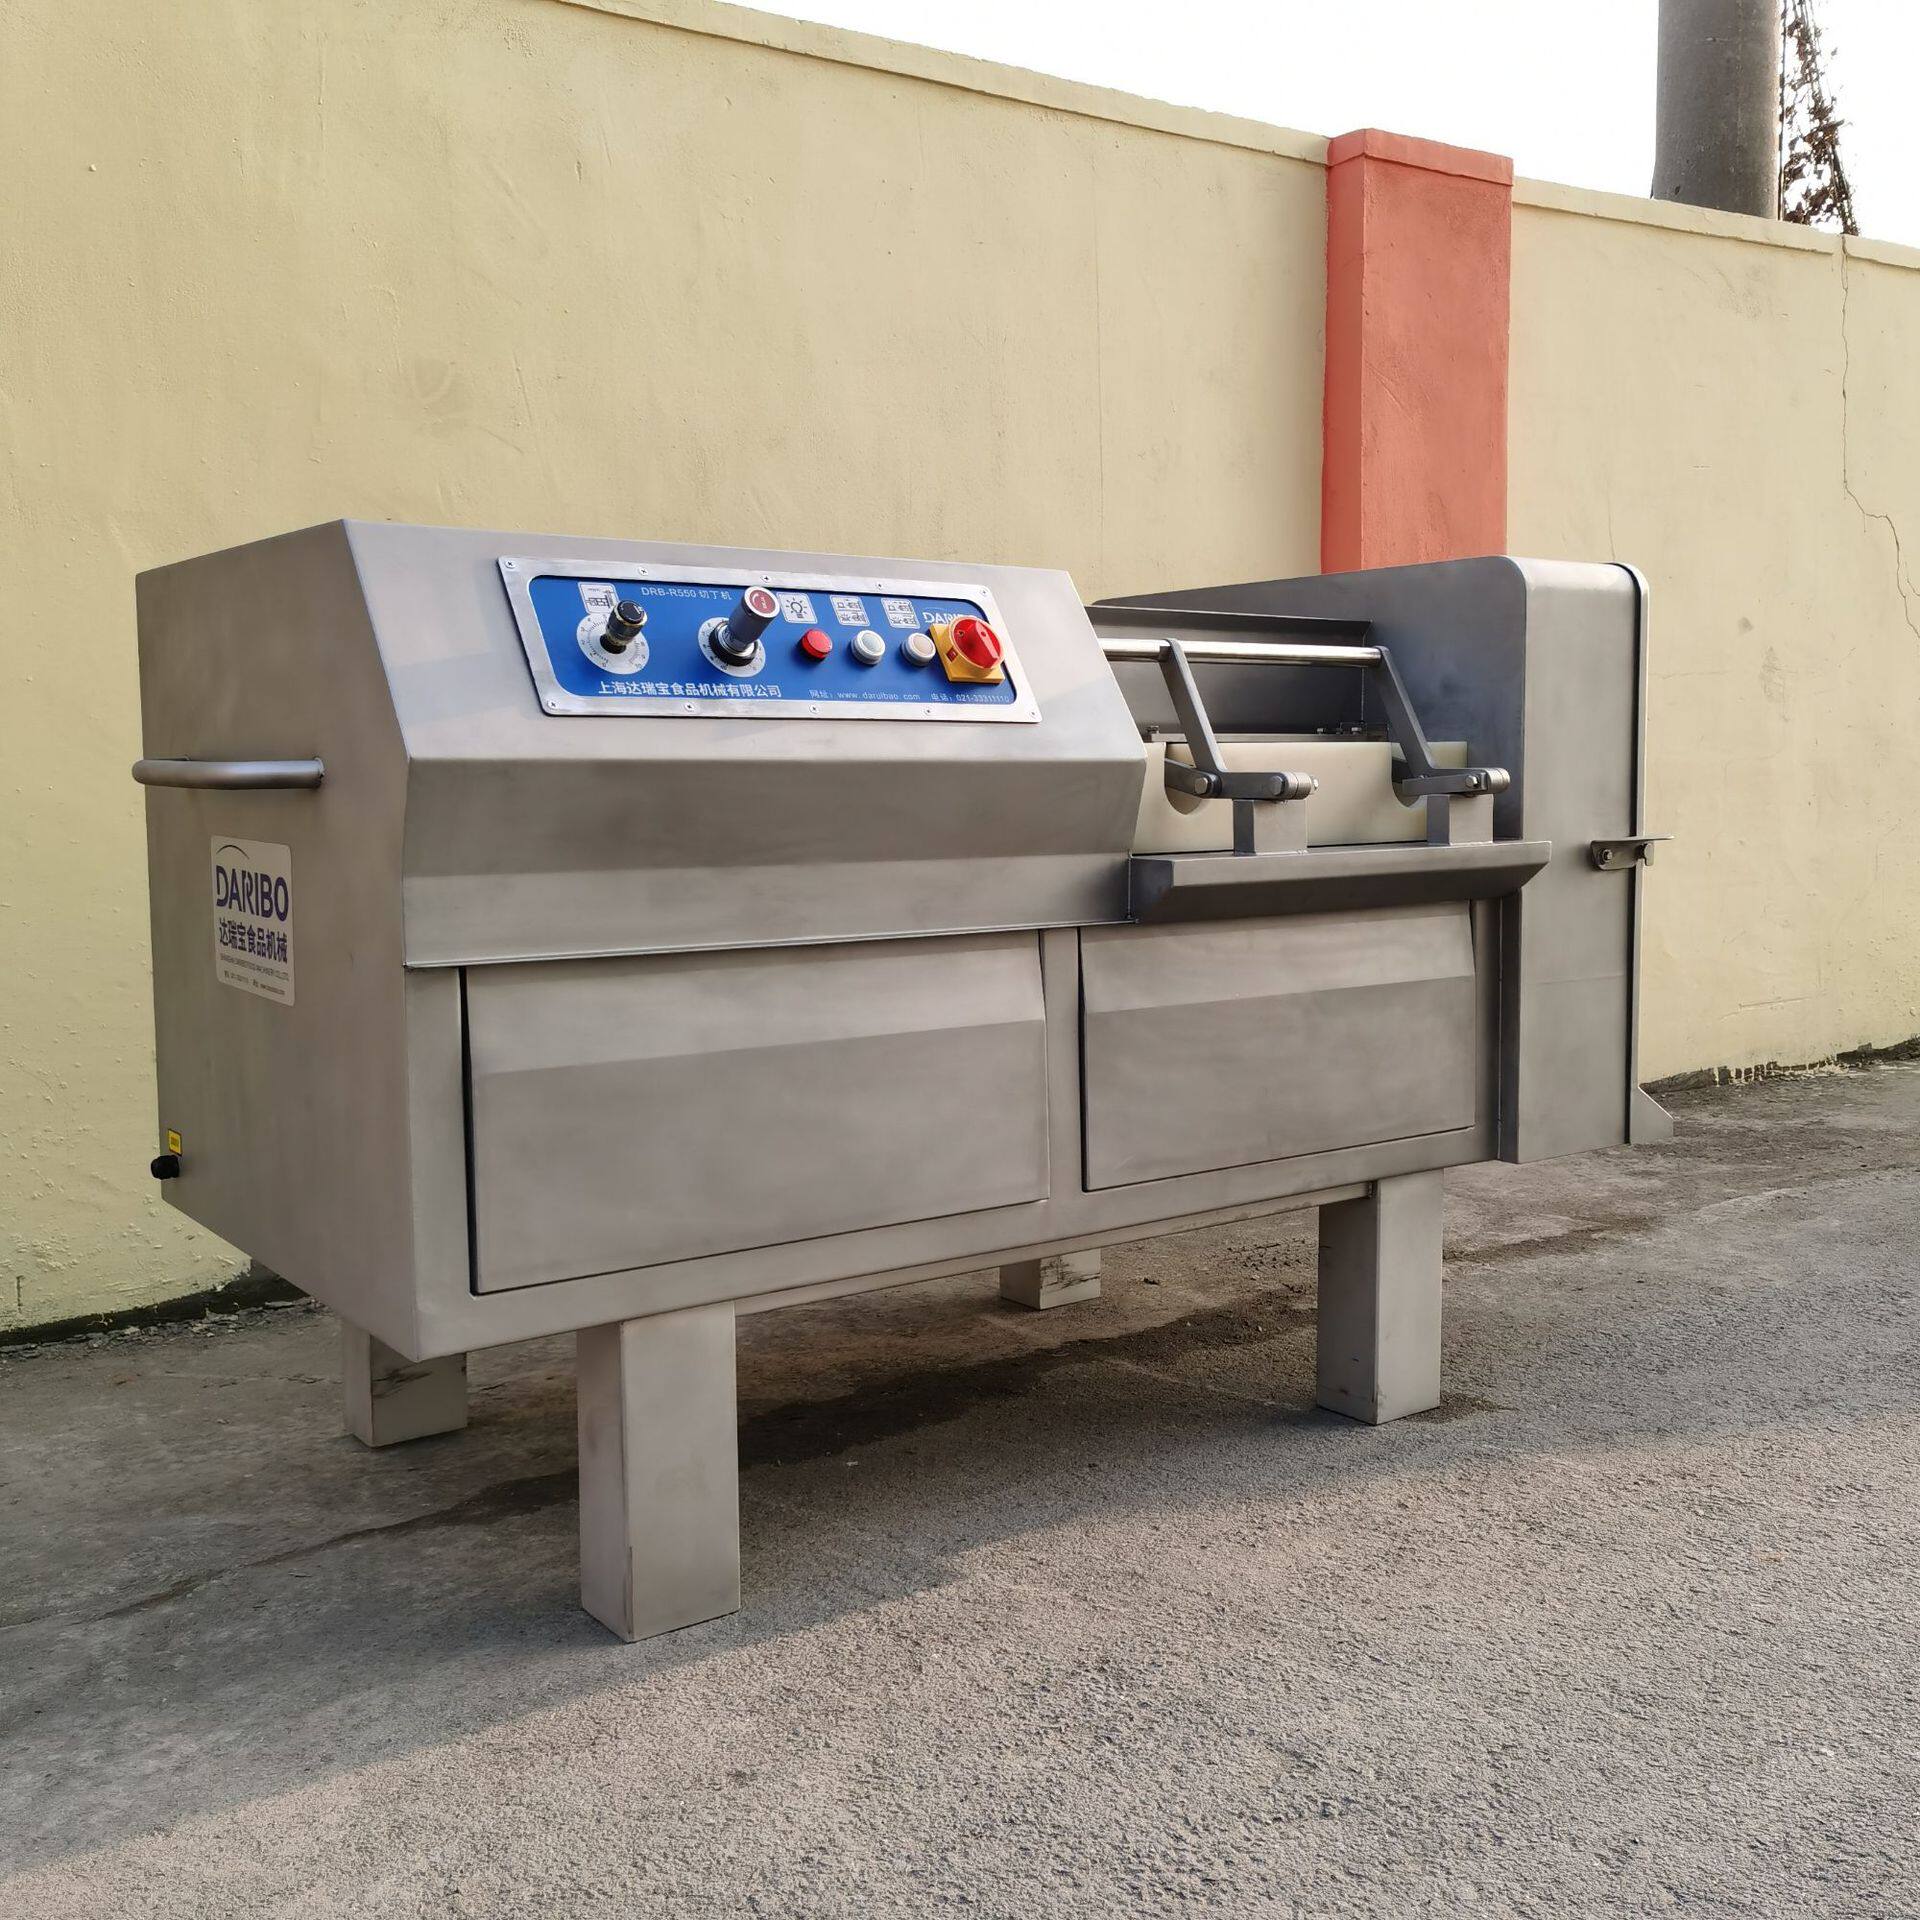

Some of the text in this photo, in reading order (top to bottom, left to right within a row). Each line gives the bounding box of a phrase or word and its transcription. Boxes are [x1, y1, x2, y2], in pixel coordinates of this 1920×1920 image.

[641, 587, 697, 598] DRB-R550
[598, 680, 782, 698] 上海达瑞宝食品机械有限公司
[216, 865, 289, 922] DARIBO
[219, 917, 288, 964] 达瑞宝食品机械
